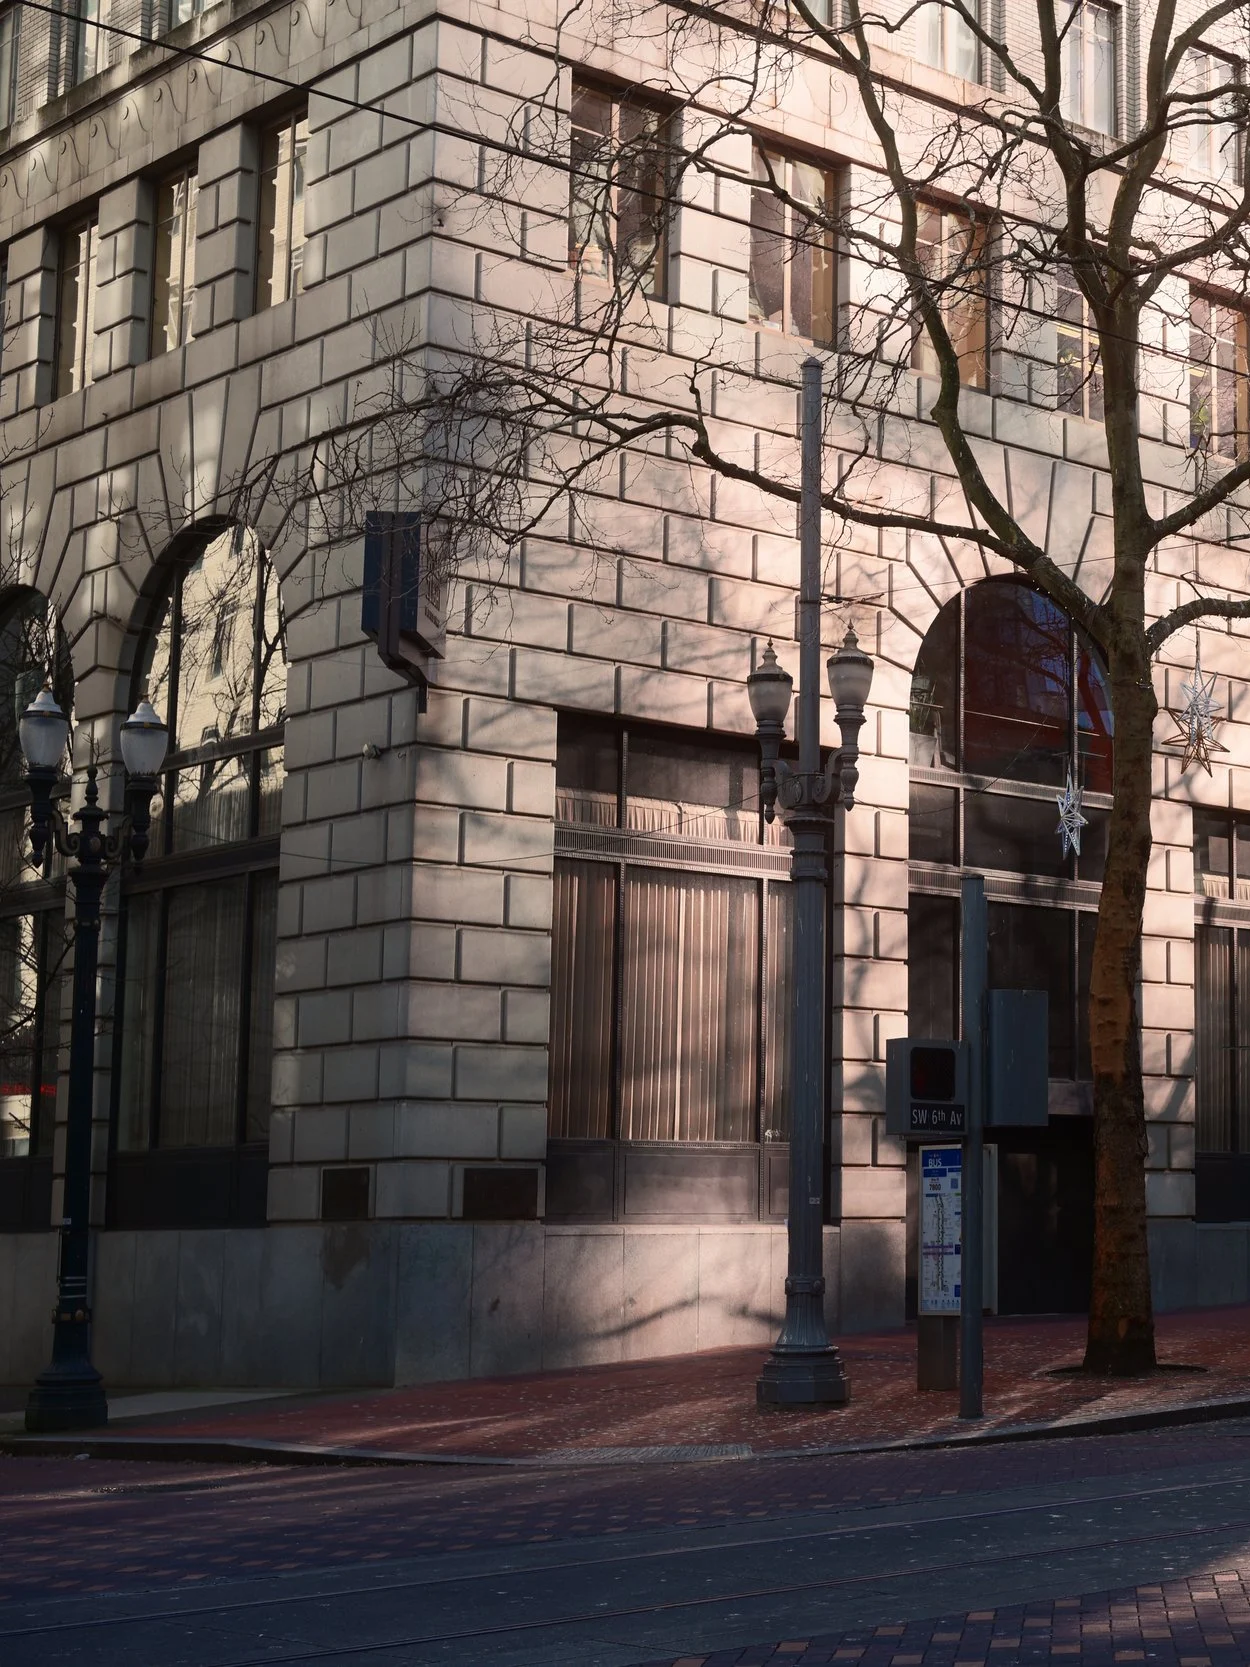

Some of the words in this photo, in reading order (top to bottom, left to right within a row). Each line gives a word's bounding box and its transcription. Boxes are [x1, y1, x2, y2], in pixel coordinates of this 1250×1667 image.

[912, 1109, 928, 1124] SW
[931, 1109, 946, 1125] 6th
[928, 1158, 942, 1167] BUS
